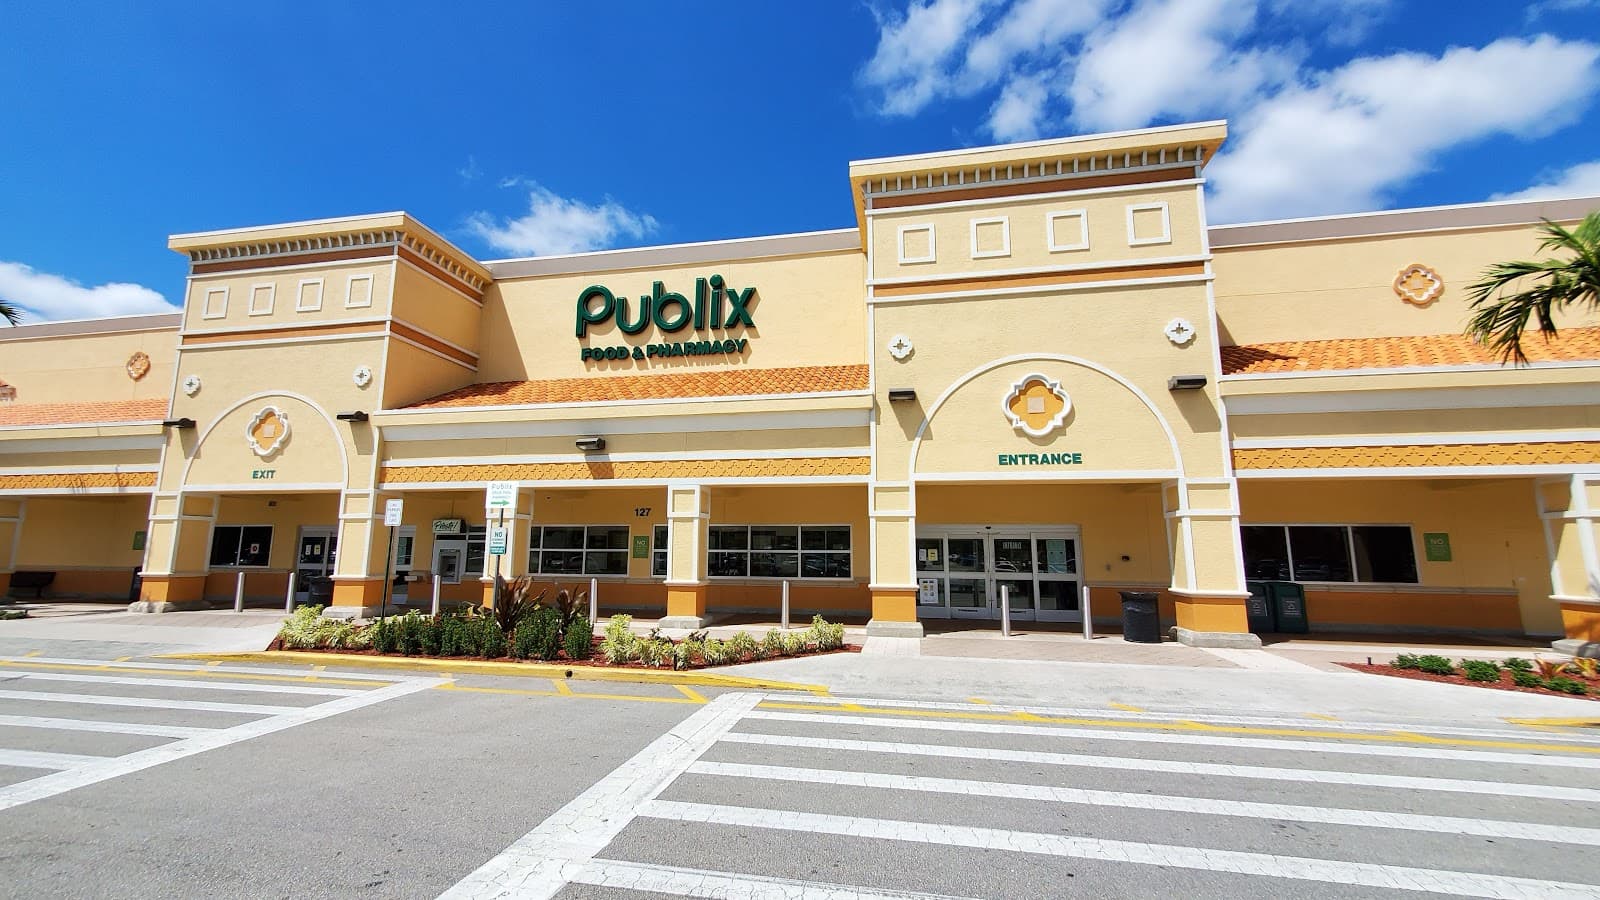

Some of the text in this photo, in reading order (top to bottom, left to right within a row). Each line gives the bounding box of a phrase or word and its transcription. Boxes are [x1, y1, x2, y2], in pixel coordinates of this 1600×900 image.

[576, 274, 757, 338] Publix
[581, 339, 748, 361] FOOD & PHARMACY
[998, 453, 1083, 465] ENTRANCE
[253, 470, 276, 479] EXIT
[634, 508, 651, 517] 127
